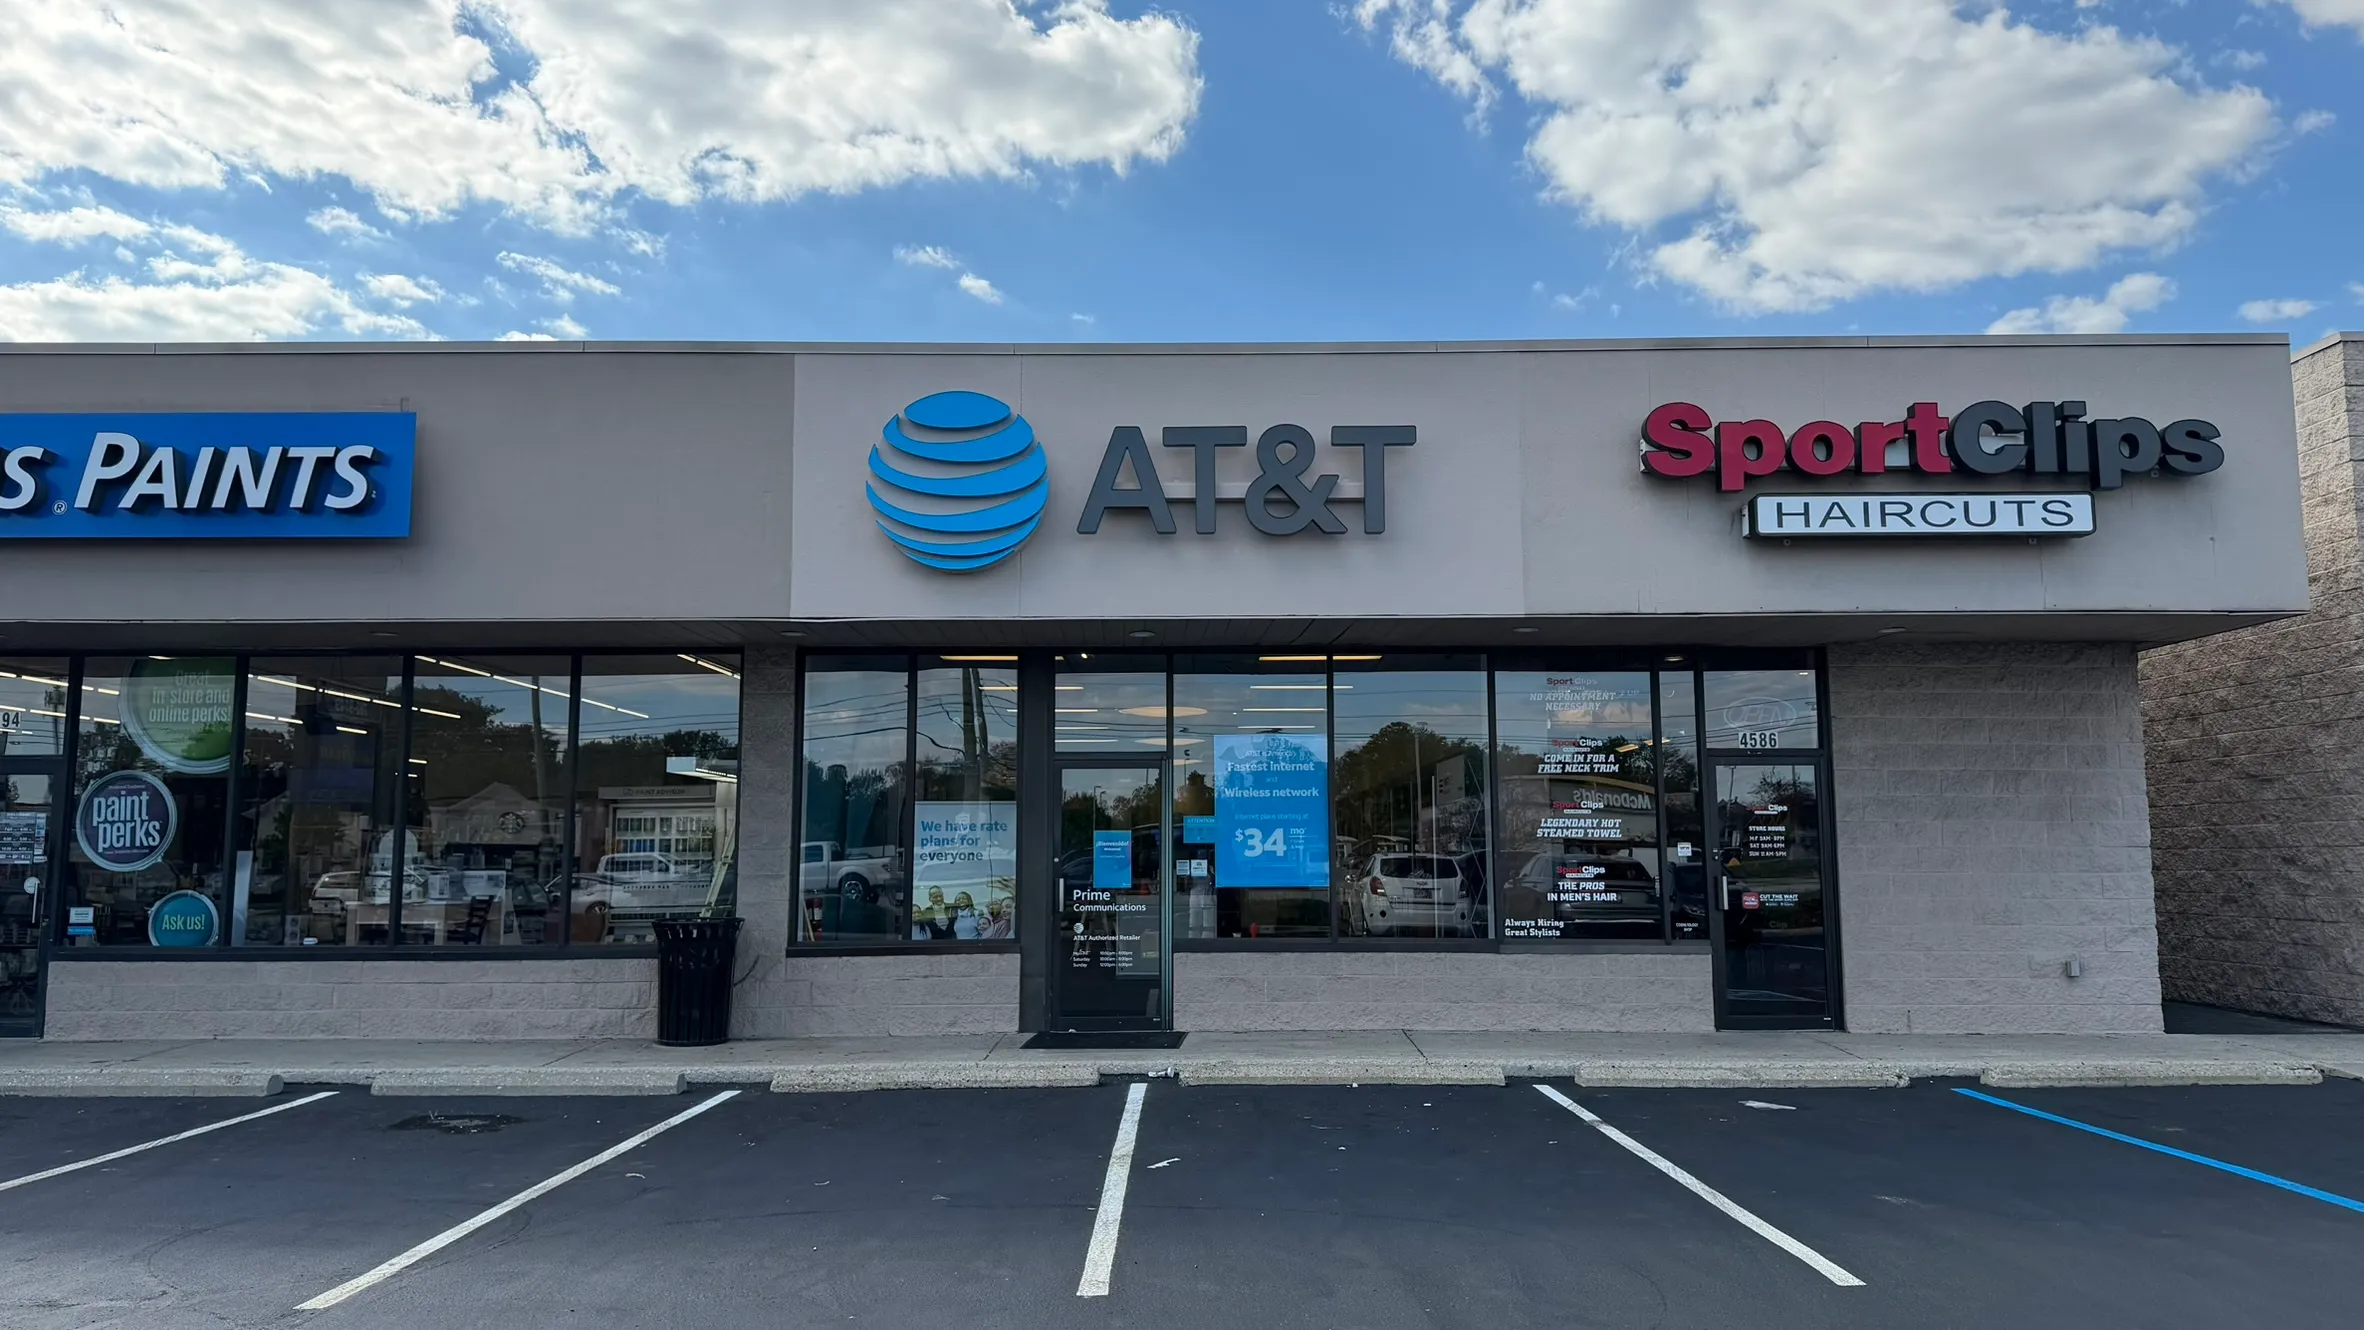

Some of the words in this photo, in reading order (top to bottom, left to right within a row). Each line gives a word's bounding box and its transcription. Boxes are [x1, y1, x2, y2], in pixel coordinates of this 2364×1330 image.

[74, 432, 374, 509] PAINTS
[1077, 424, 1416, 536] AT&T
[1776, 500, 2074, 528] HAIRCUTS
[206, 687, 230, 704] and
[1545, 692, 1617, 701] APPOINTMENT
[1545, 702, 1601, 711] NECESSARY
[149, 704, 190, 722] online
[192, 705, 232, 724] perks!
[1740, 733, 1777, 748] 4586
[1544, 754, 1572, 763] COME
[1573, 754, 1585, 763] IN
[1587, 754, 1605, 763] FOR
[1607, 754, 1615, 763] A
[1228, 761, 1268, 772] Fastest
[1538, 764, 1563, 773] FREE
[1564, 764, 1591, 773] NECK
[1593, 764, 1619, 773] TRIM
[1225, 787, 1271, 798] Wireless
[1272, 787, 1320, 798] network
[92, 790, 150, 828] paint
[921, 820, 942, 832] We
[944, 820, 977, 832] have
[980, 821, 1008, 832] rate
[1540, 818, 1599, 828] LEGENDARY
[1600, 818, 1622, 828] HOT
[98, 816, 161, 853] perks
[1536, 828, 1584, 838] STEAMED
[1587, 828, 1623, 838] TOWEL
[920, 834, 957, 849] plans
[959, 834, 981, 847] for
[1234, 827, 1288, 858] $34
[919, 851, 984, 864] everyone
[1557, 881, 1579, 890] THE
[1579, 881, 1606, 890] PROS
[1073, 889, 1111, 900] Prime
[1546, 892, 1559, 902] IN
[1560, 892, 1591, 902] MEN'S
[1592, 892, 1618, 902] HAIR
[1073, 902, 1147, 912] Communications
[162, 914, 185, 931] Ask
[186, 914, 206, 931] us!
[1504, 918, 1536, 927] Always
[1537, 918, 1565, 928] Hiring
[1504, 928, 1529, 937] Great
[1529, 928, 1561, 938] Stylists
